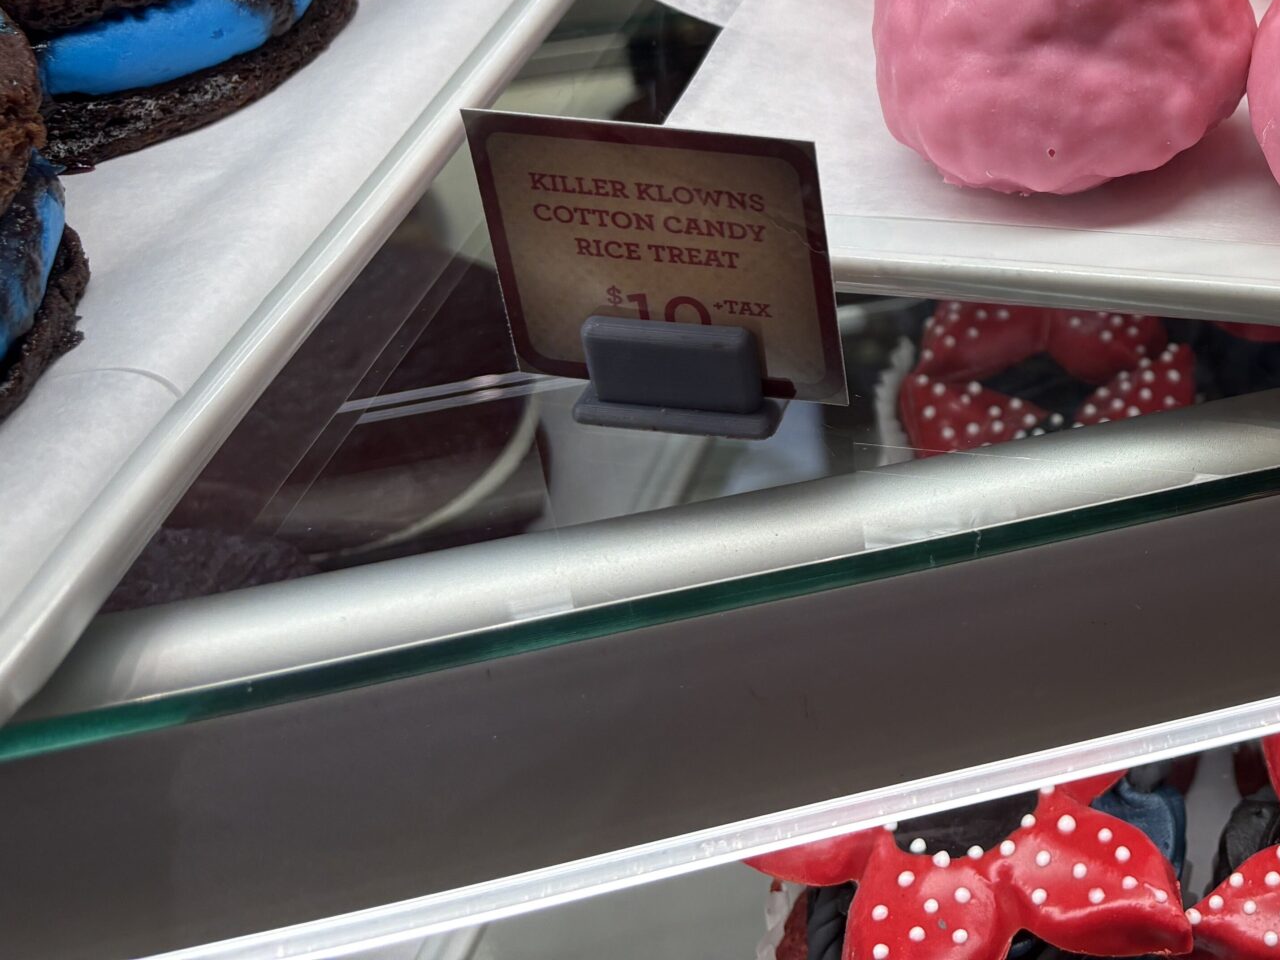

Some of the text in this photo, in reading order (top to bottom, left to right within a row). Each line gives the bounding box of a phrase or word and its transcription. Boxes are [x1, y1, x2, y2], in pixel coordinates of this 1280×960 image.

[528, 172, 765, 212] KILLER KLOWNS
[533, 204, 766, 242] COTTON CANDY
[574, 237, 740, 269] RICE TREAT
